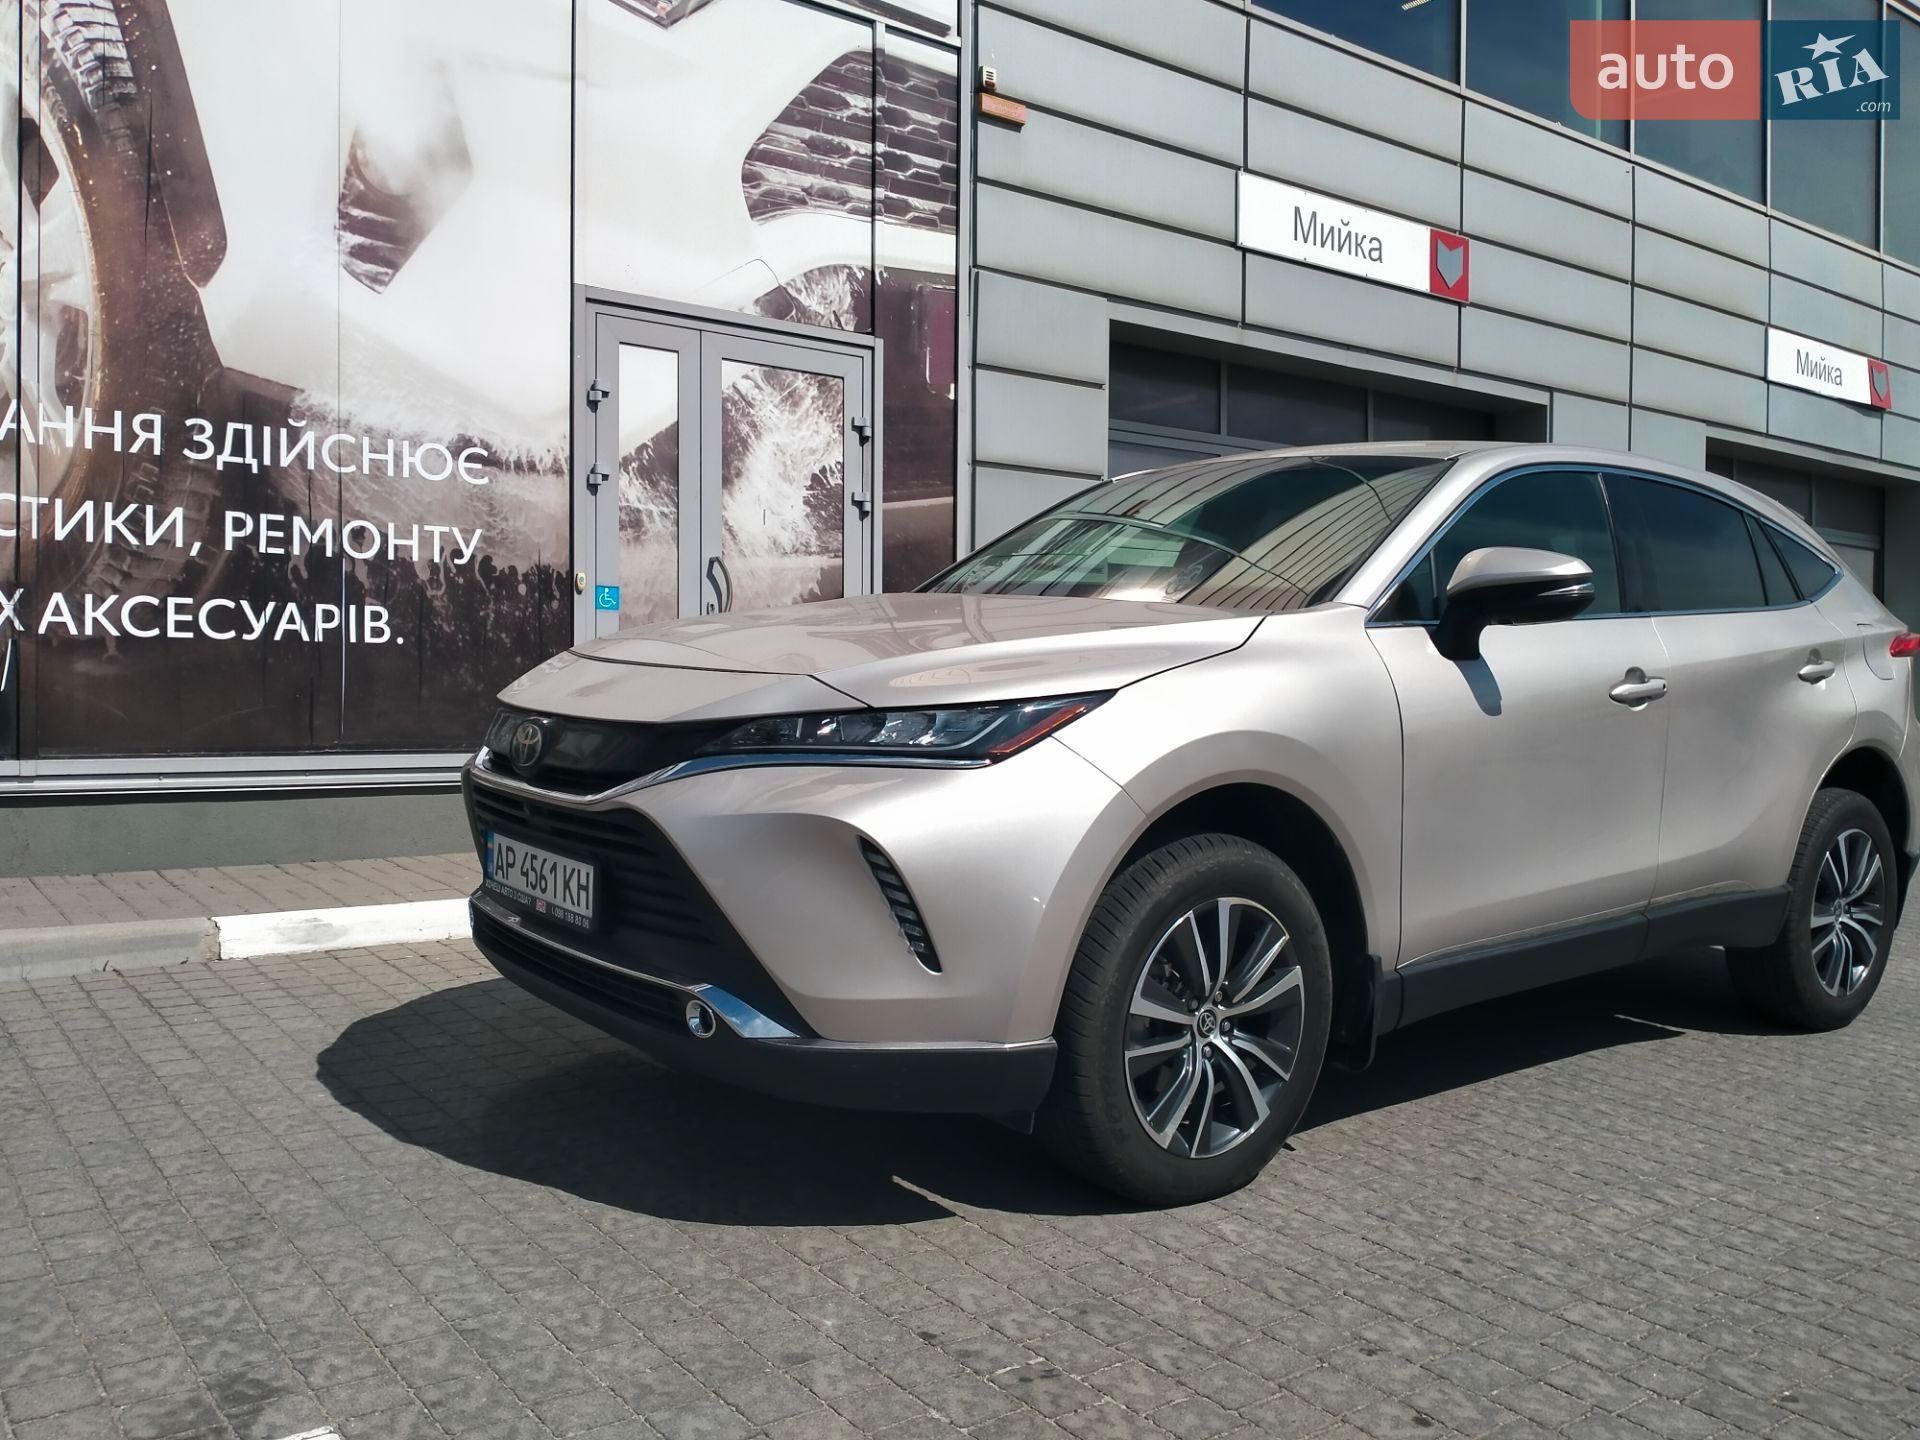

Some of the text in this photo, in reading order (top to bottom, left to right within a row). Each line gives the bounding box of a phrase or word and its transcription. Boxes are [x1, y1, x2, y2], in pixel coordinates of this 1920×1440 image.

[1293, 206, 1383, 264] Мийка
[1796, 349, 1843, 386] Мийка
[182, 417, 490, 486] ЗДІЙСНЮЄ
[224, 511, 483, 565] РЕМОНТУ
[37, 591, 405, 645] АКСЕСУАРІВ.
[495, 843, 590, 910] AP 4561 KH
